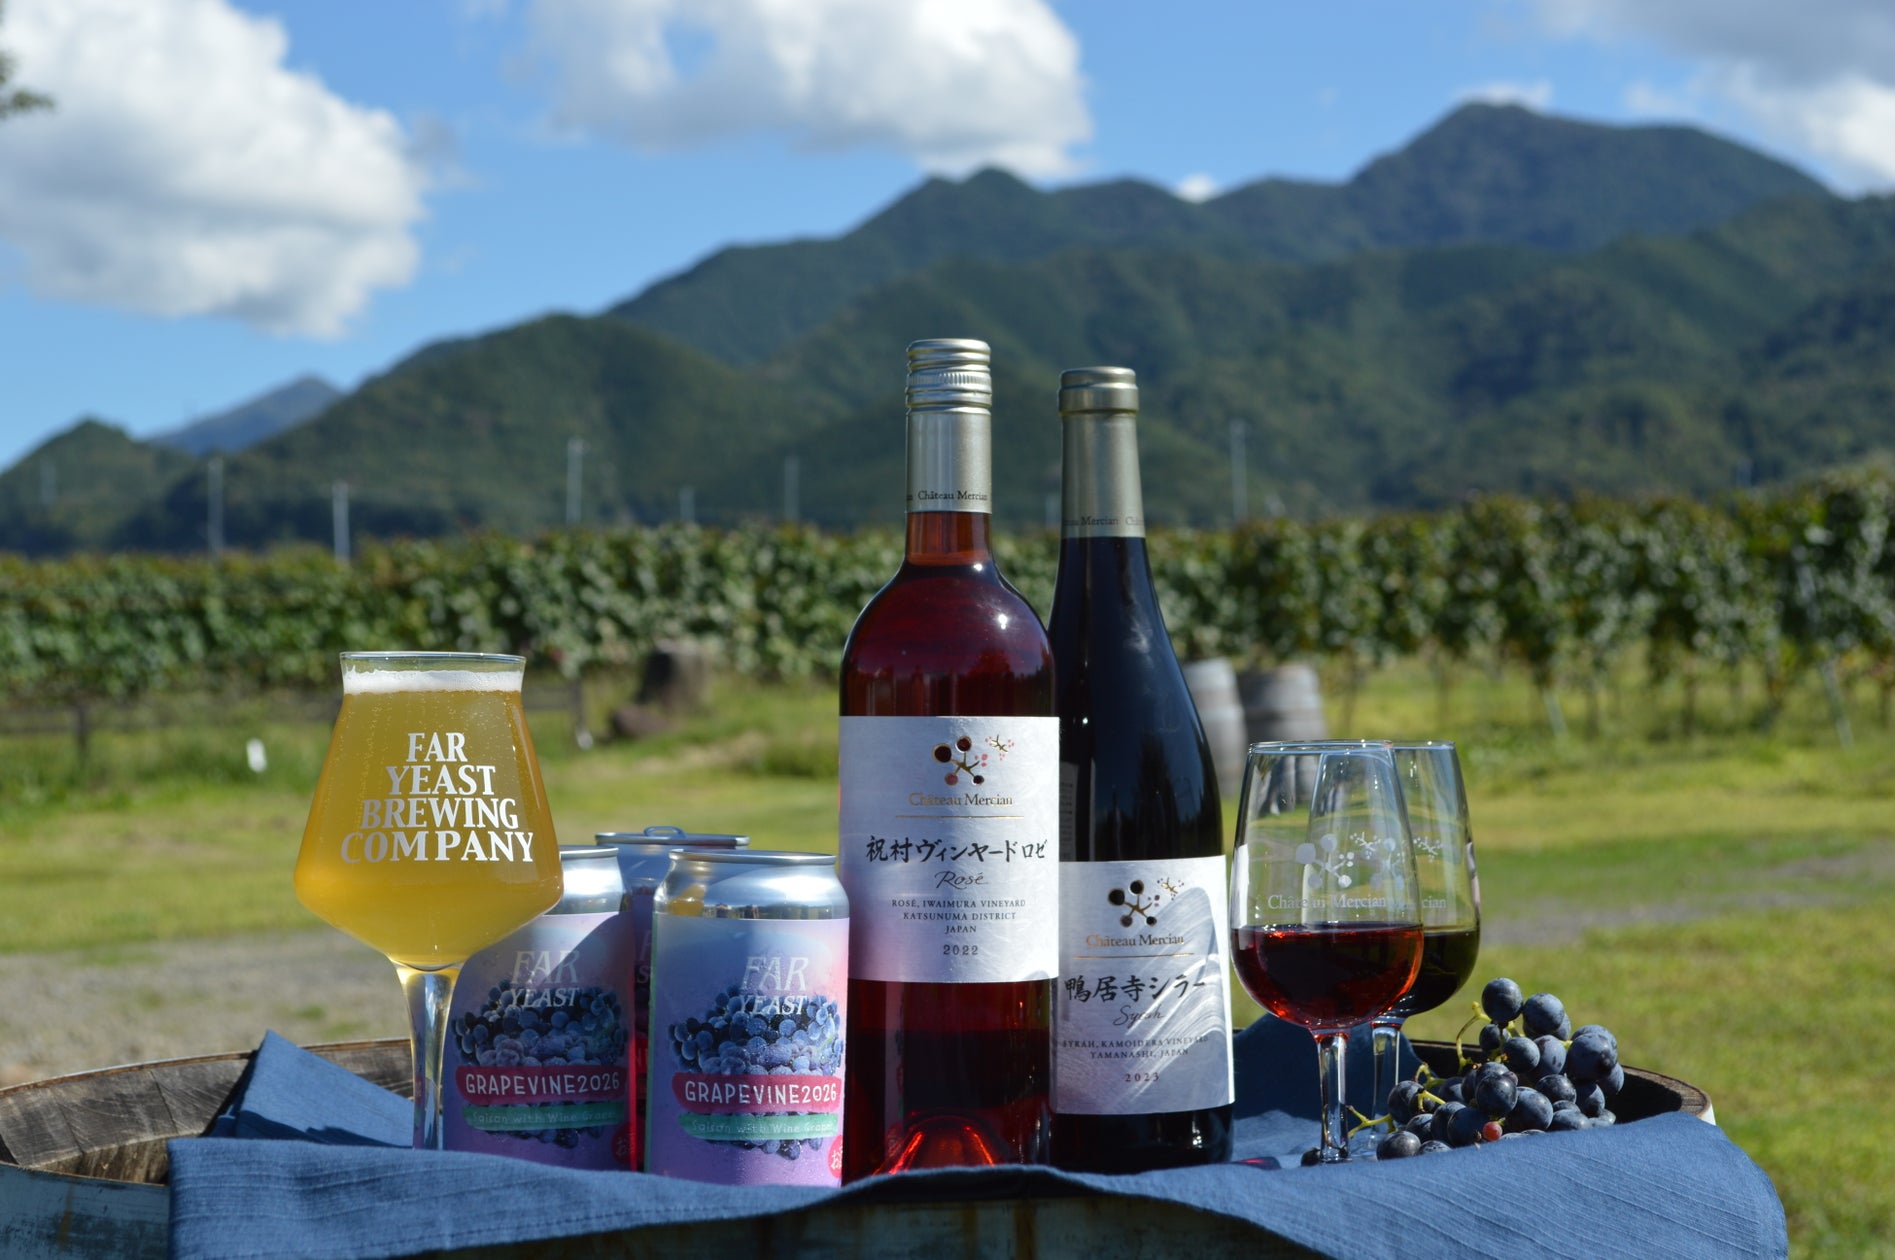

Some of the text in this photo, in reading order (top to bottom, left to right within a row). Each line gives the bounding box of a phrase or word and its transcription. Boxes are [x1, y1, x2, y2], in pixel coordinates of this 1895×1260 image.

[406, 732, 468, 763] FAR
[386, 765, 496, 795] YEAST
[908, 793, 1013, 806] Château Mercian
[359, 798, 519, 829] BREWING
[340, 830, 534, 863] COMPANY
[934, 871, 988, 890] Rosé
[923, 900, 977, 909] IWAIMURA
[981, 899, 1026, 908] VINEYARD
[1331, 894, 1386, 910] Mercian
[903, 912, 1016, 921] KATSUNUMA DISTRICT
[945, 925, 977, 935] JAPAN
[1086, 934, 1184, 947] Château Mercian
[943, 945, 979, 956] 2022
[512, 951, 579, 983] FAR
[740, 956, 810, 991] FAR
[509, 987, 580, 1009] YEAST
[1064, 974, 1206, 1003] 鴨居寺シラー
[738, 994, 808, 1015] YEAST
[465, 1072, 621, 1096] GRAPEVINE2026
[1124, 1071, 1161, 1083] 2023
[684, 1080, 838, 1105] GRAPEVINE2026
